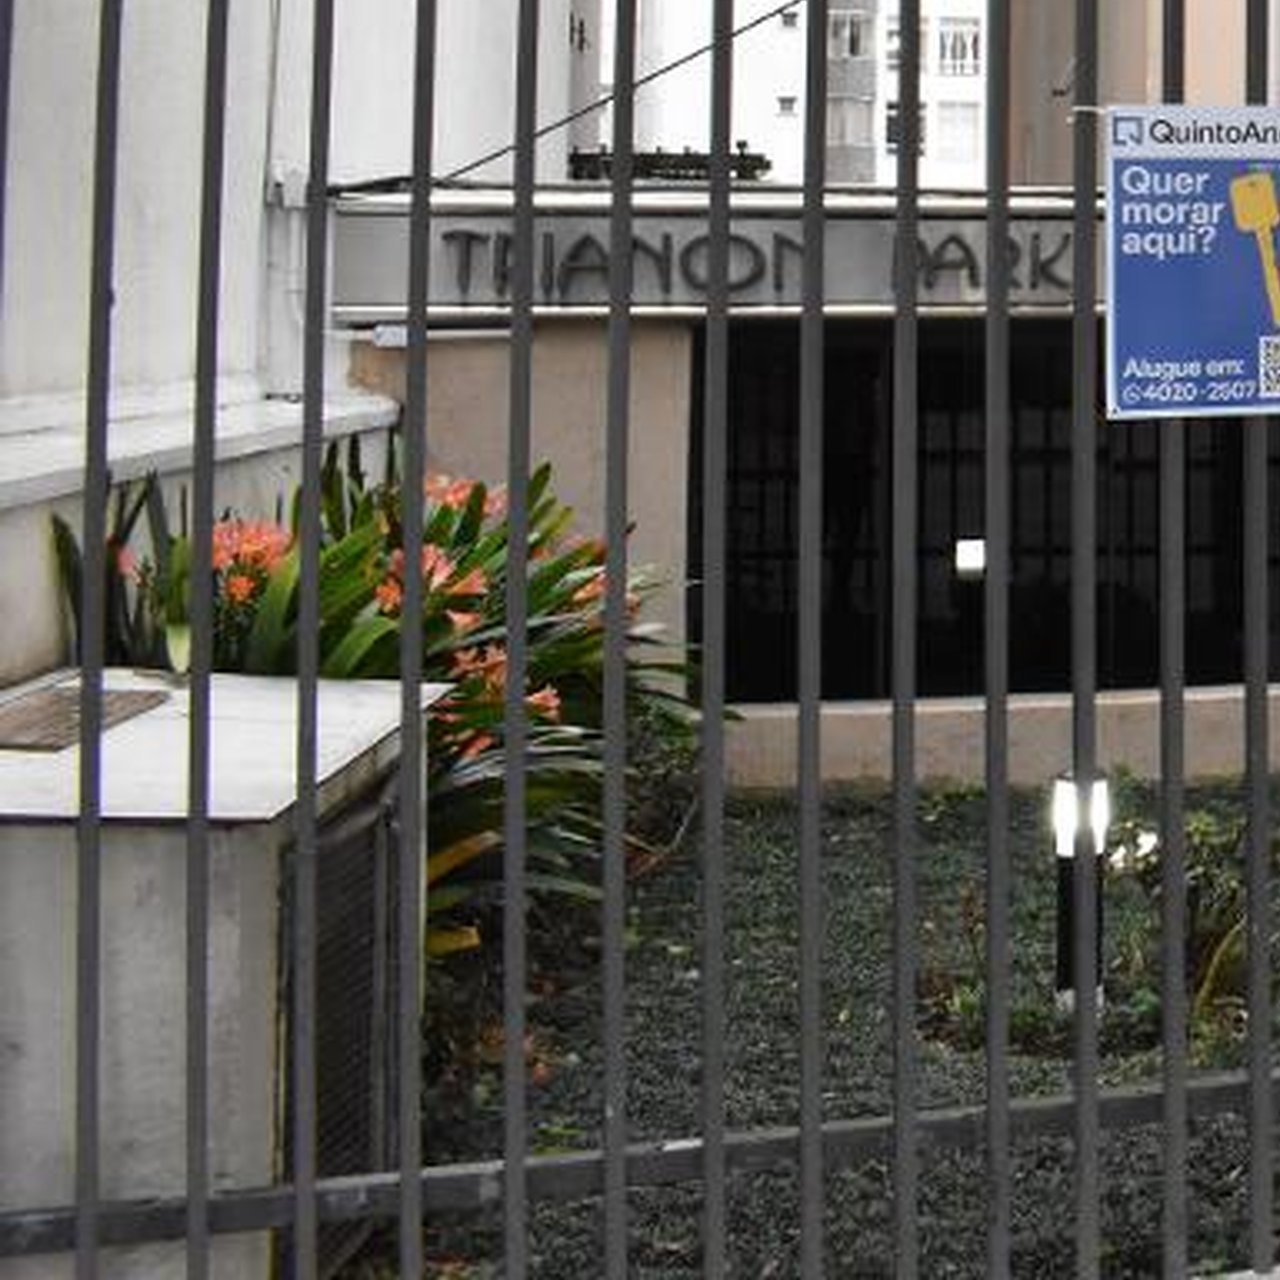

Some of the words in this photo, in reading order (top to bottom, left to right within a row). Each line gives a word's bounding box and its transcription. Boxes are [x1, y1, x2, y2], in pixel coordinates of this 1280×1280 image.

[1121, 166, 1209, 195] Quer
[1122, 201, 1224, 224] morar
[1121, 227, 1215, 260] aqui?
[1123, 357, 1201, 381] Alugue
